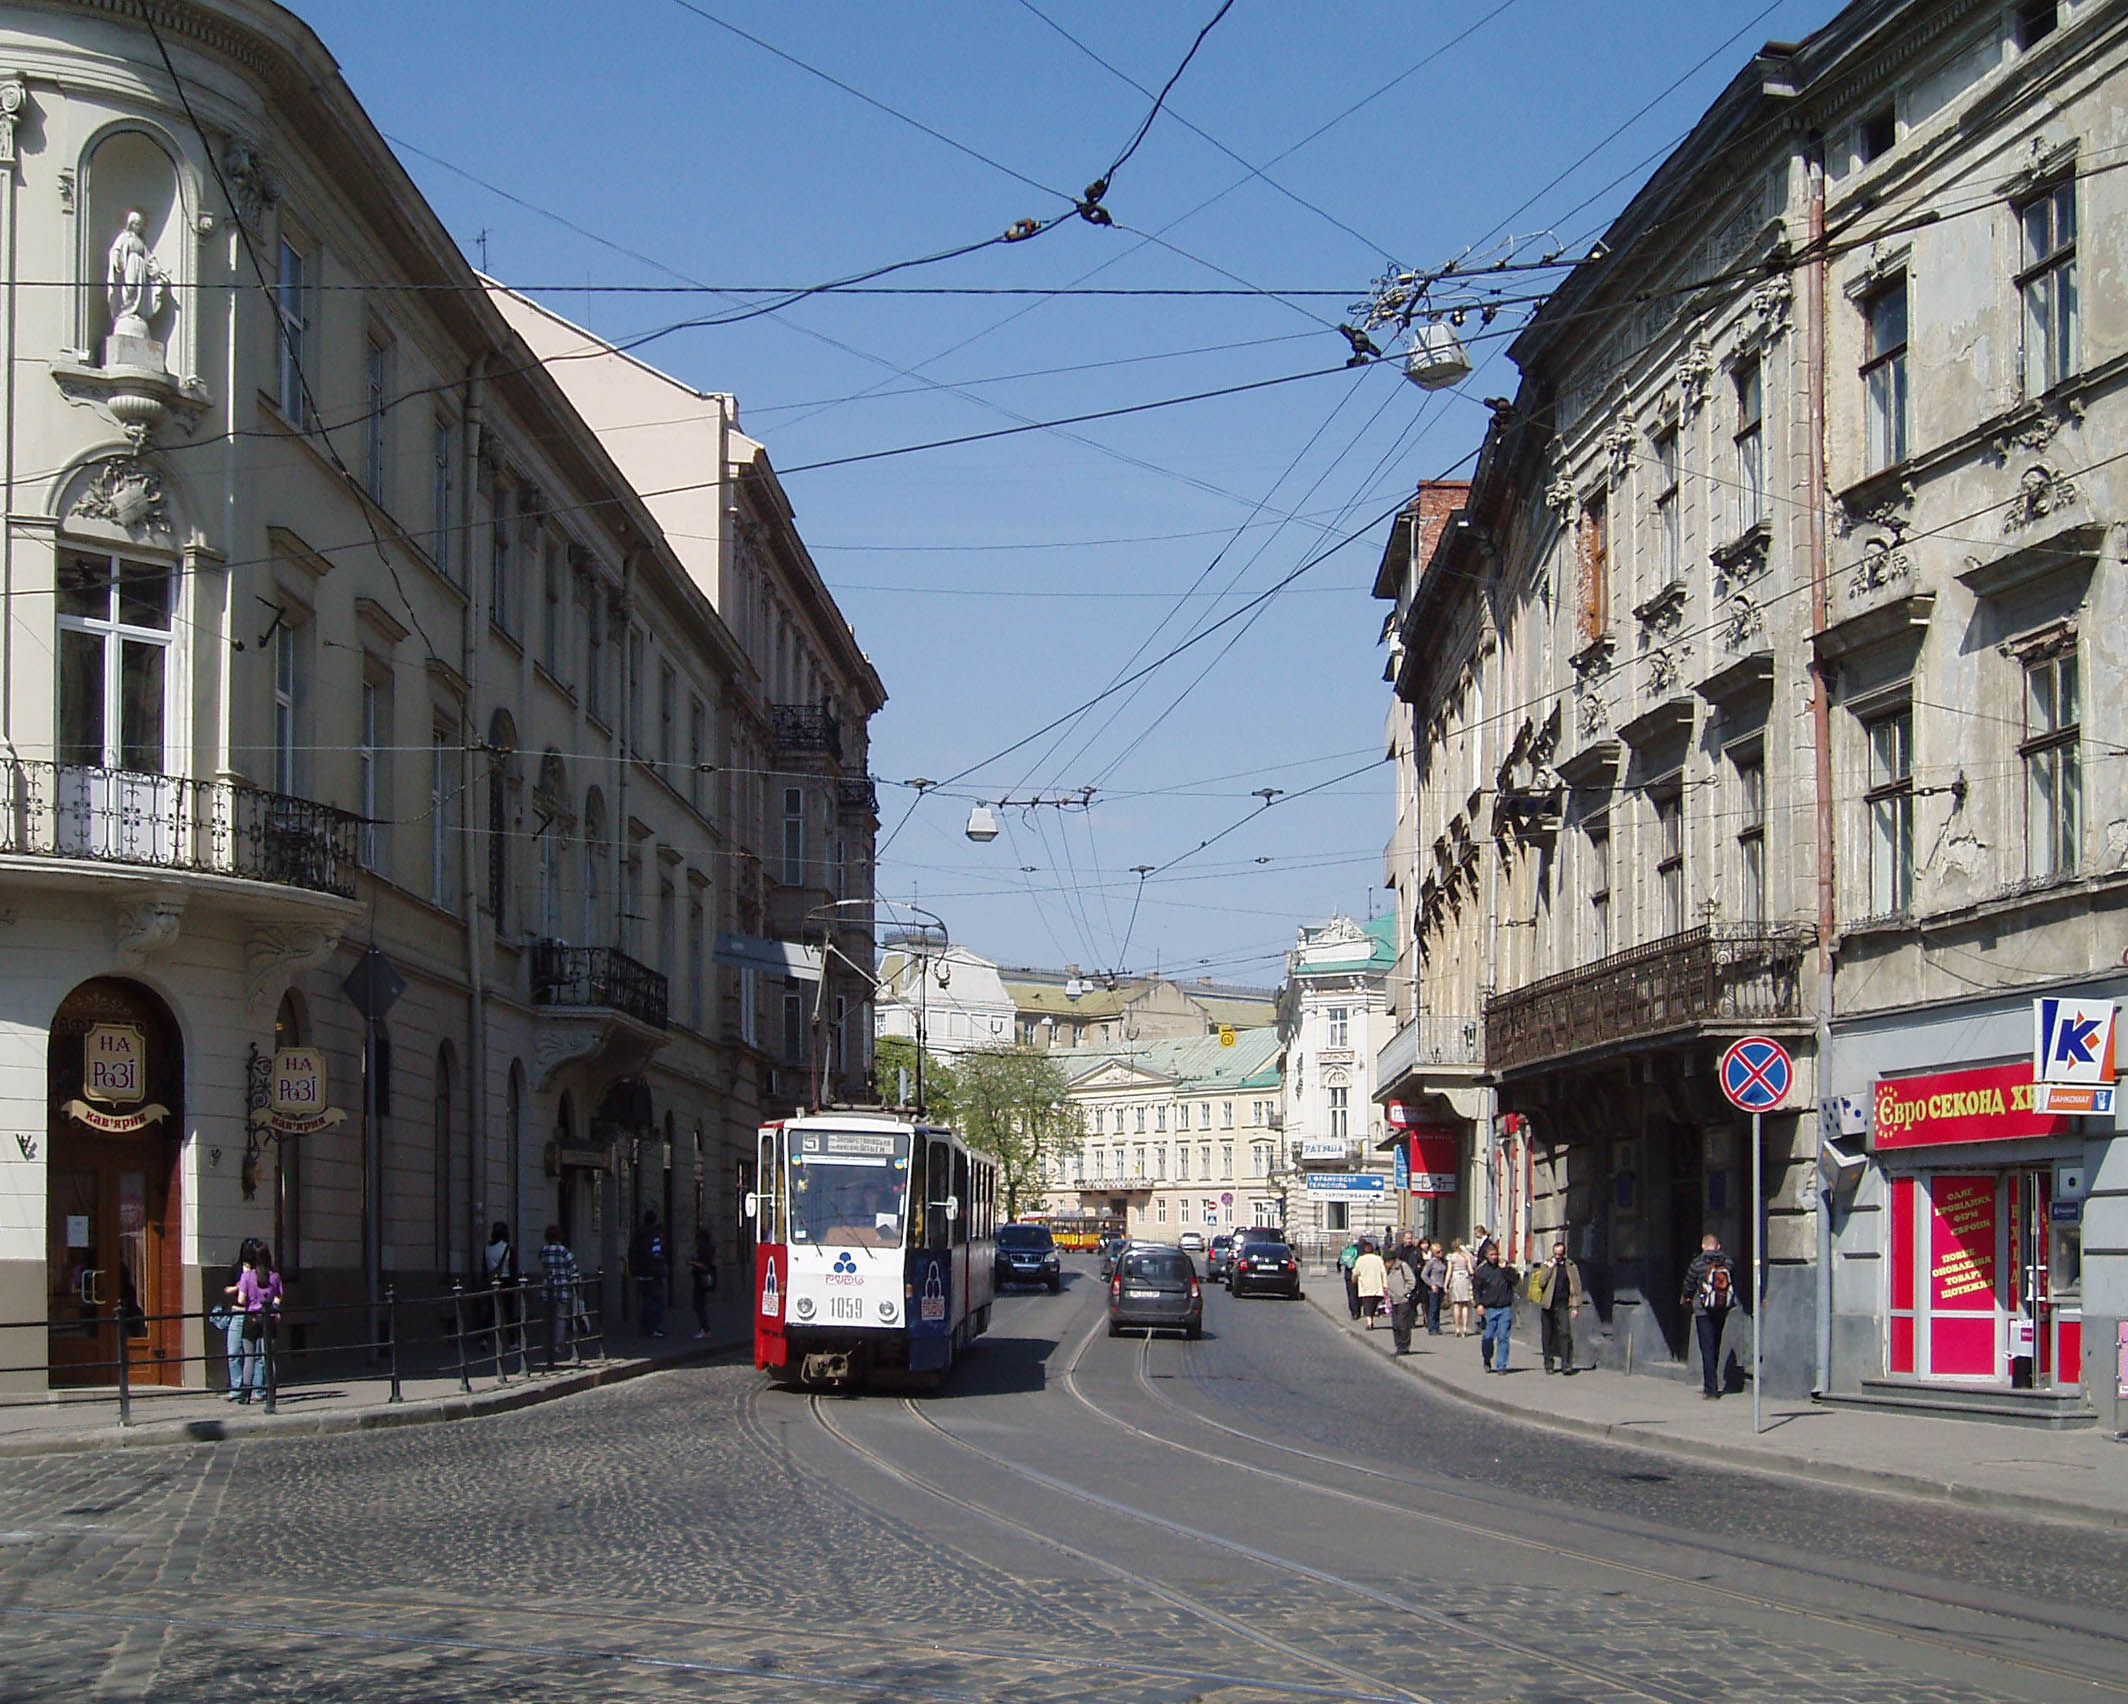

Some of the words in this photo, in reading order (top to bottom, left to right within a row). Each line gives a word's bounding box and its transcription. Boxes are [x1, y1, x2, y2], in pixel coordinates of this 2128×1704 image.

[100, 1035, 131, 1052] НА
[285, 1057, 313, 1071] НА
[2050, 1095, 2090, 1104] БАНКОМАТ
[1879, 1096, 1927, 1131] Євро
[1929, 1088, 2006, 1119] СЕКОНД
[804, 1135, 816, 1150] 5
[1304, 1144, 1344, 1153] РАТУША
[1945, 1269, 1984, 1286] ТОВАРУ
[1940, 1278, 1995, 1299] ЩОТИЖНЯ
[830, 1296, 863, 1320] 1059
